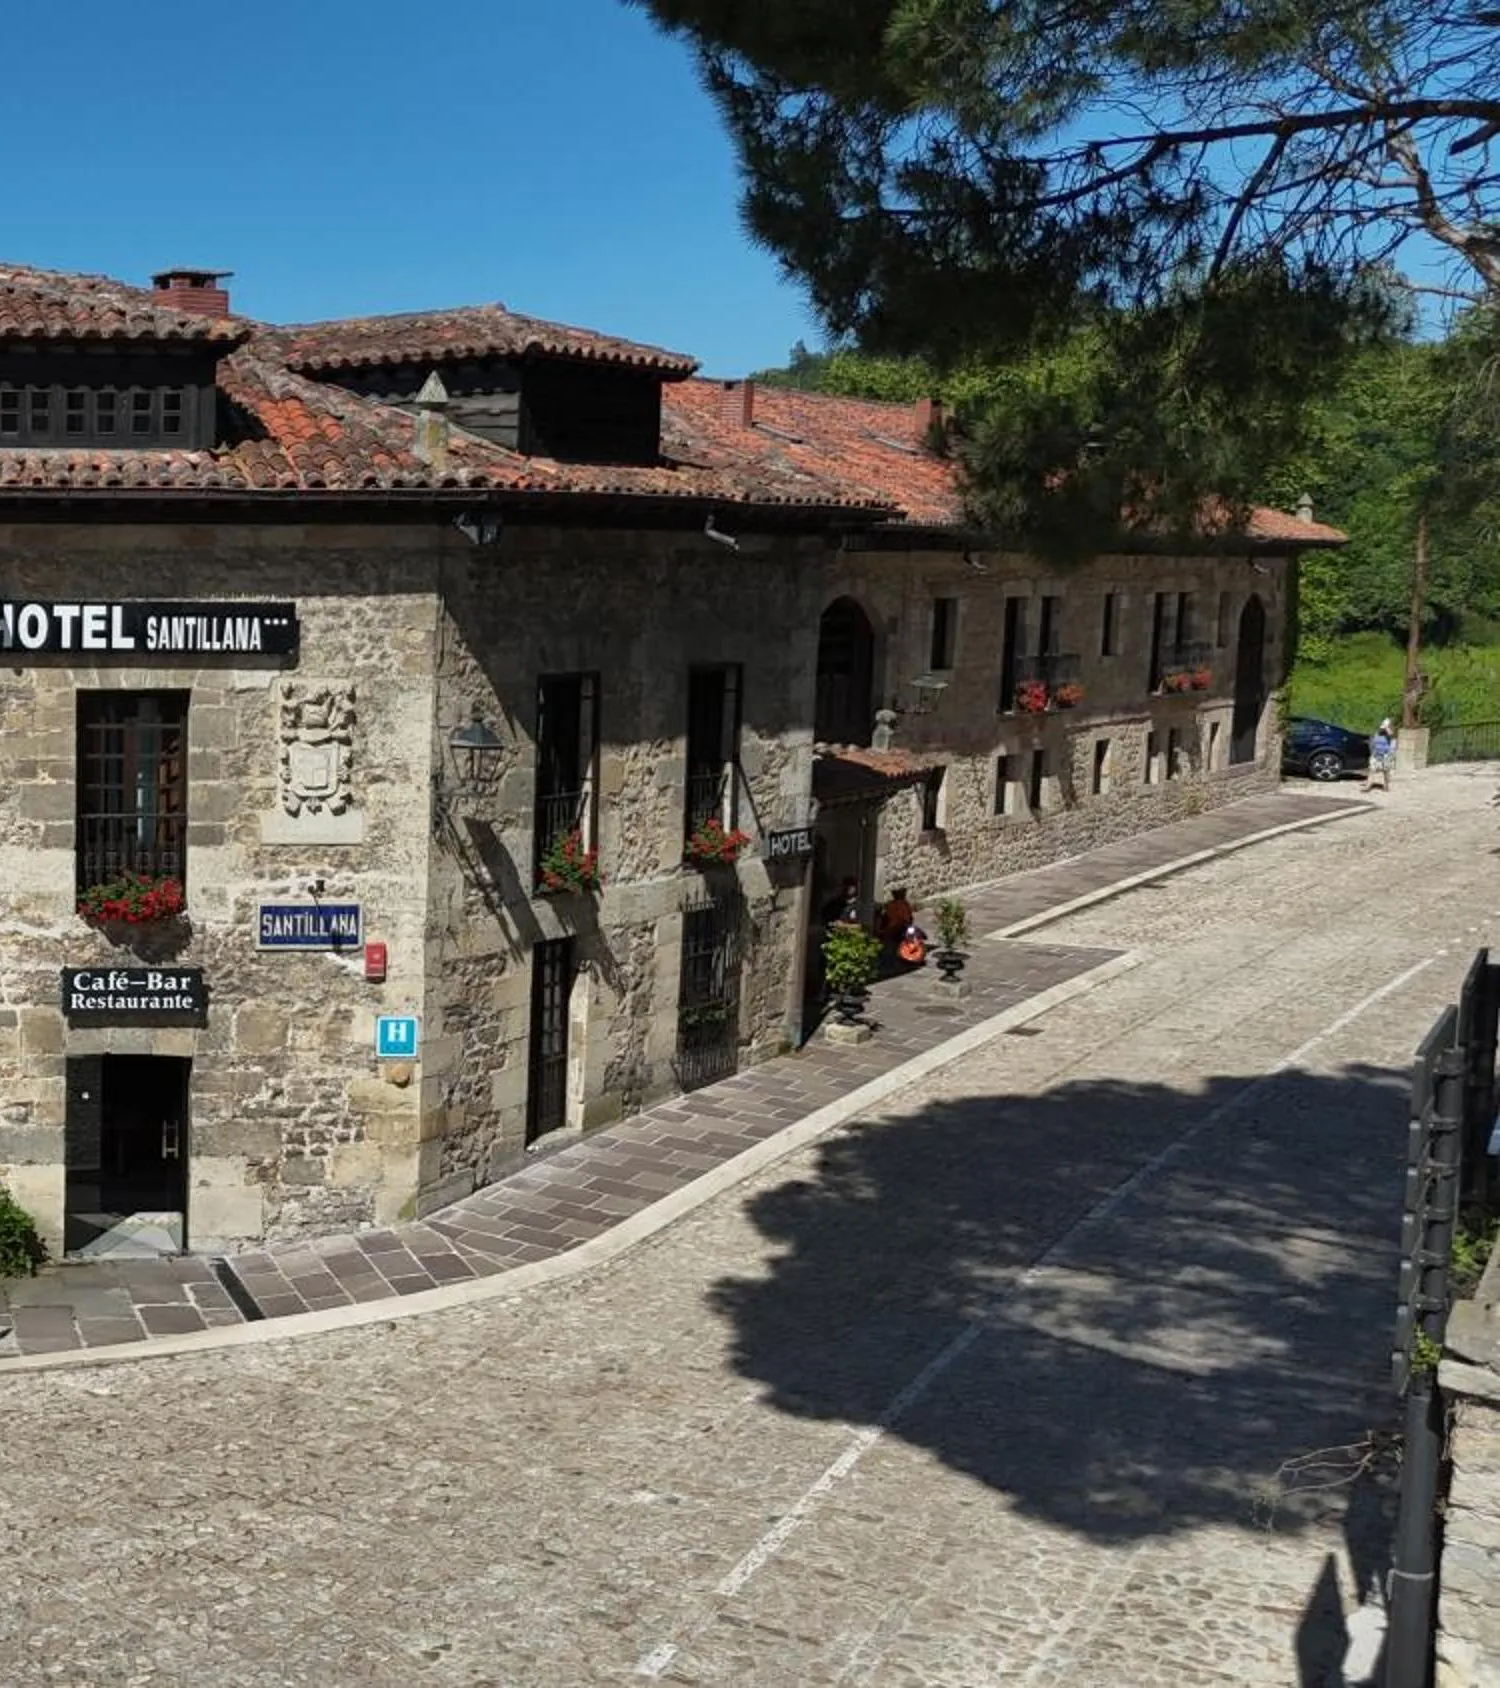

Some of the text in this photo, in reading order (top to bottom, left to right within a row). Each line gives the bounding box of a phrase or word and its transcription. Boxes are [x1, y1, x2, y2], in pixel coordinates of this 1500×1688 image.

[146, 616, 261, 651] SANTILLANA
[771, 832, 812, 856] HOTEL
[262, 911, 357, 938] SANTILLANA
[70, 992, 194, 1010] Restaurante
[387, 1022, 407, 1042] H
